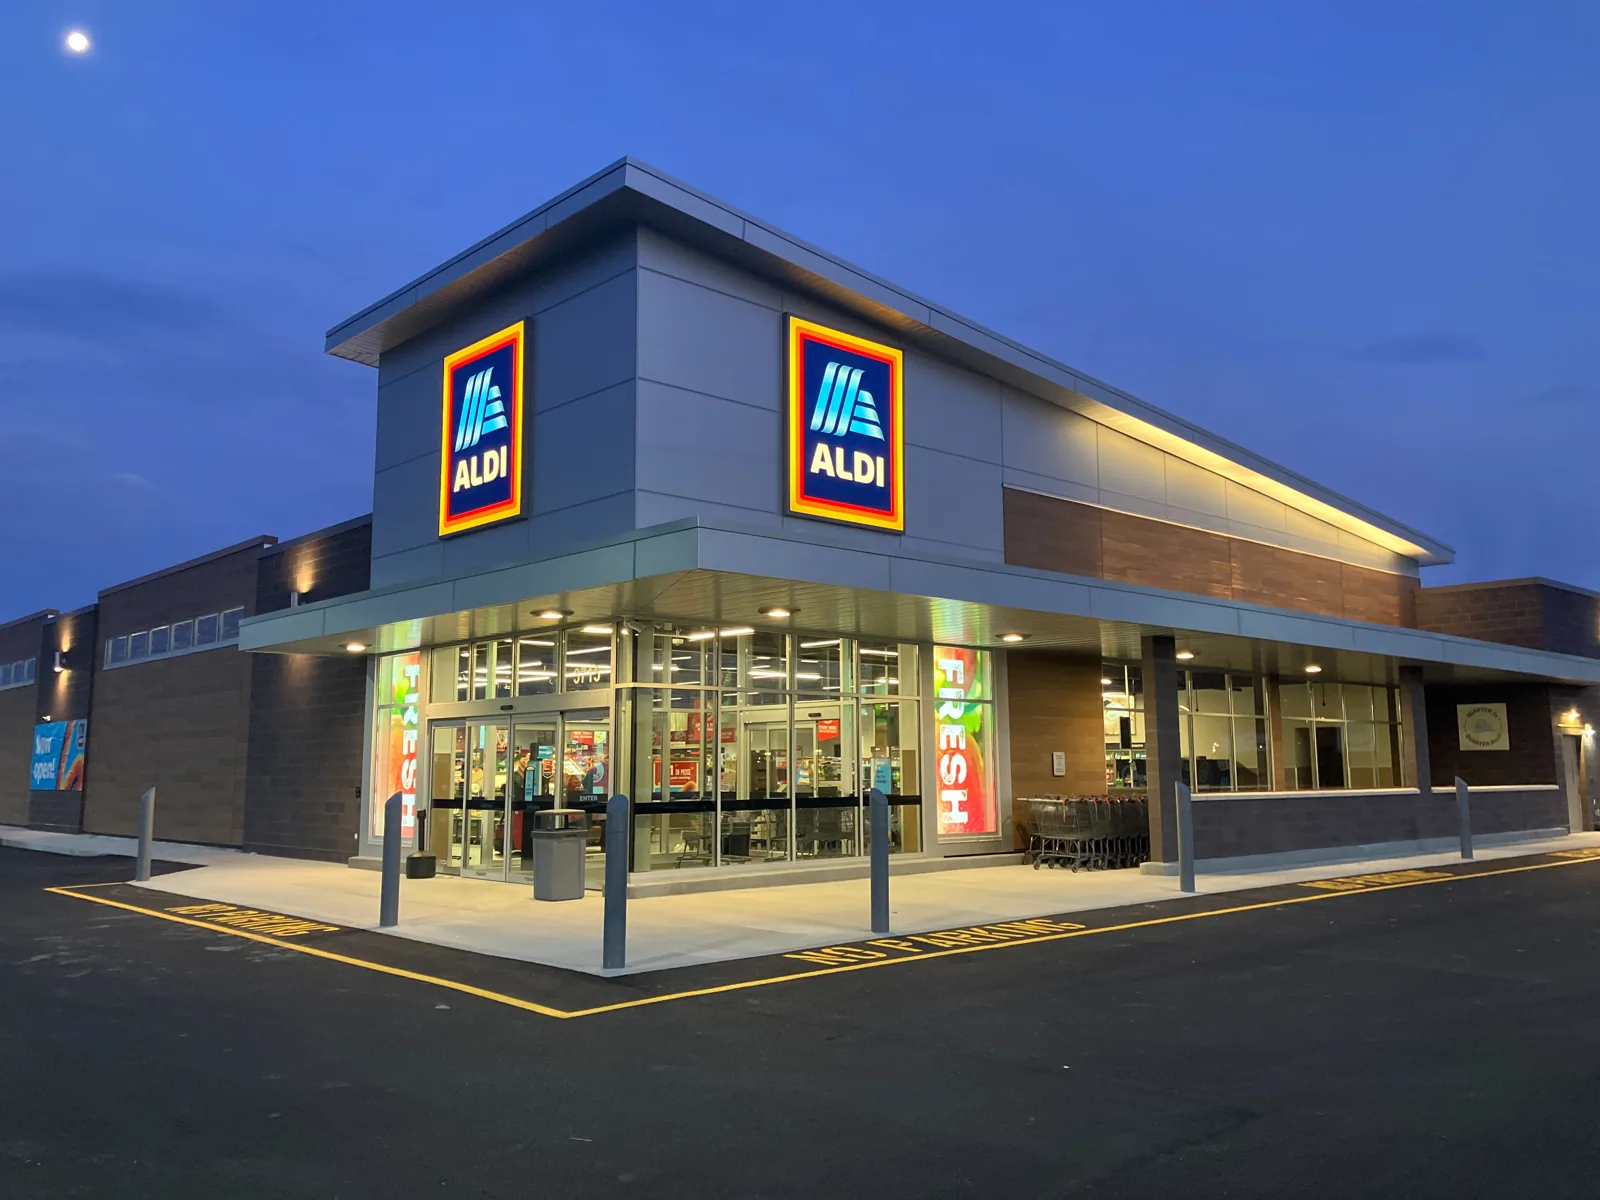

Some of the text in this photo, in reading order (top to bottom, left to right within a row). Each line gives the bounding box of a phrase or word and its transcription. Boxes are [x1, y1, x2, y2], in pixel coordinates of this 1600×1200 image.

[453, 445, 507, 493] ALDI
[810, 442, 885, 488] ALDI
[937, 658, 968, 825] FRESH
[34, 757, 56, 785] open!
[782, 918, 1086, 966] NO PARKING
